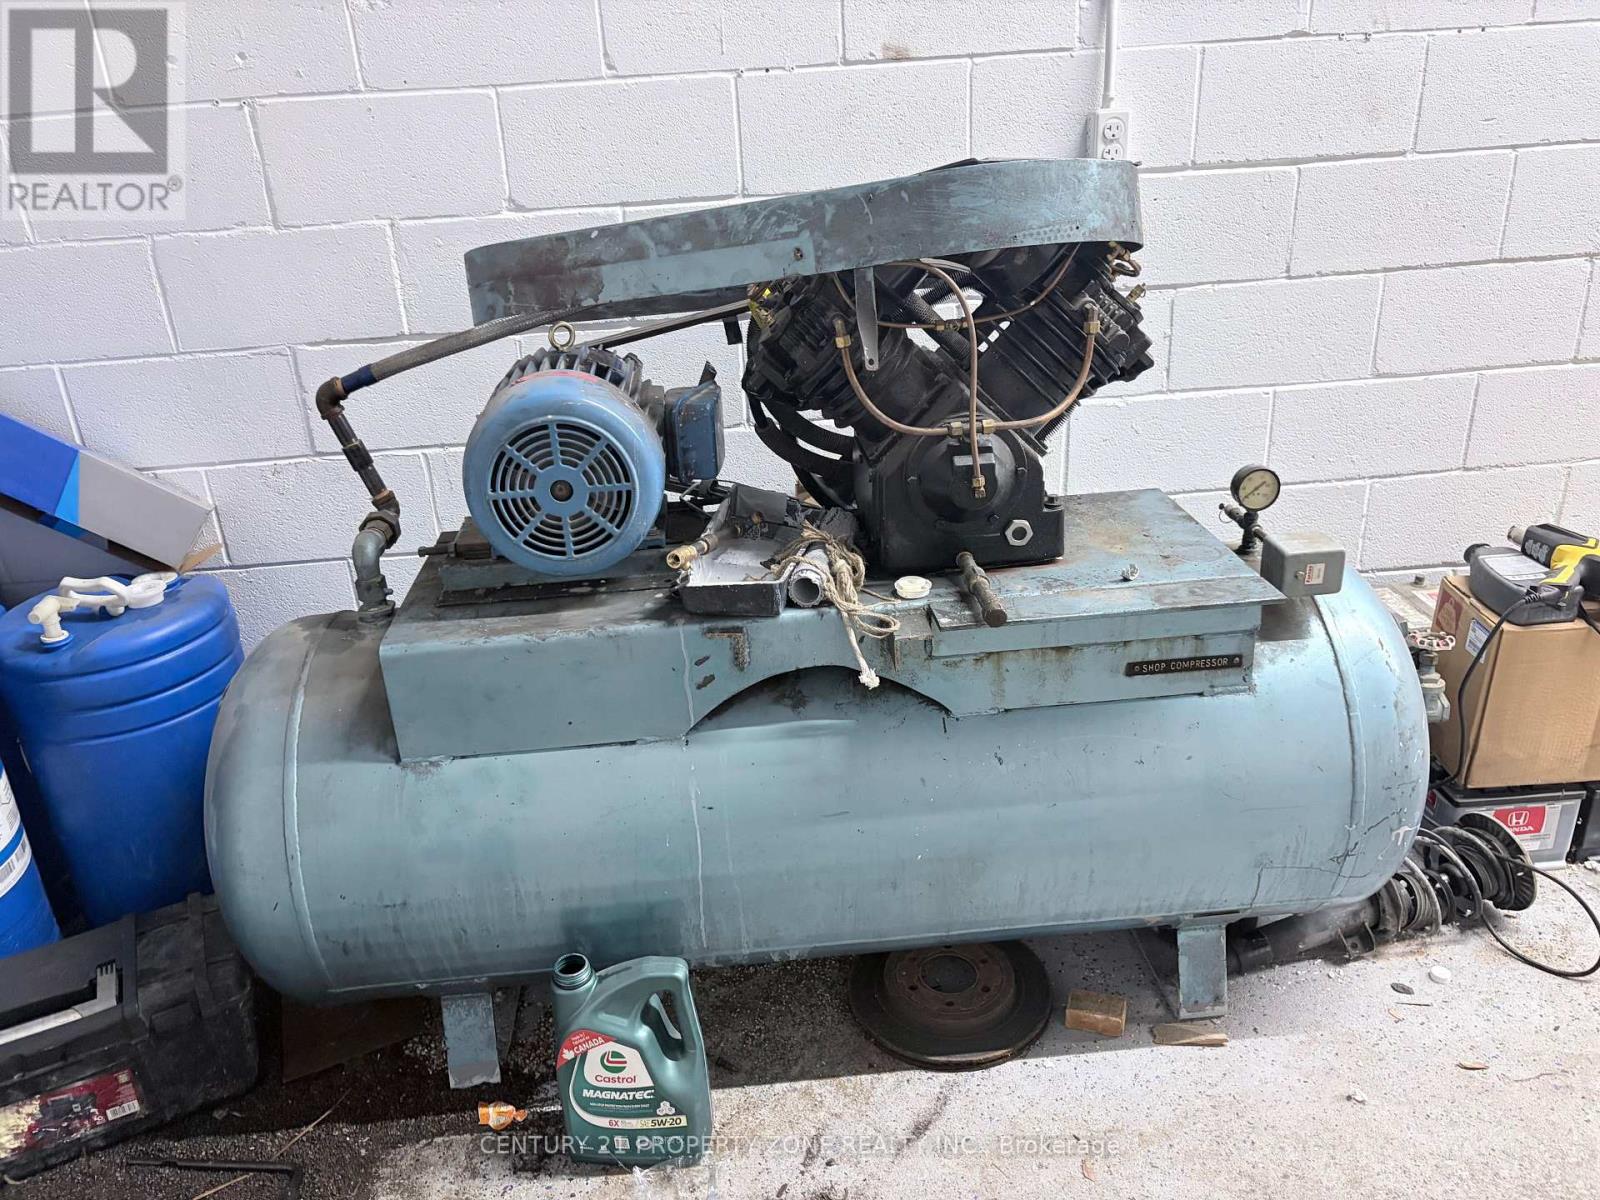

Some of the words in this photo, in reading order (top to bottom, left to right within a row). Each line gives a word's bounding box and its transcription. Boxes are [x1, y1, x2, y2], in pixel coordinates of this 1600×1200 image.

[1142, 662, 1166, 673] SHOP
[1170, 657, 1229, 670] COMPRESSOR
[573, 1036, 605, 1054] CANADA
[594, 1074, 637, 1084] Castrol
[582, 1089, 655, 1100] MAGNATEC
[608, 1119, 620, 1127] 6X
[651, 1117, 682, 1127] 5W-20
